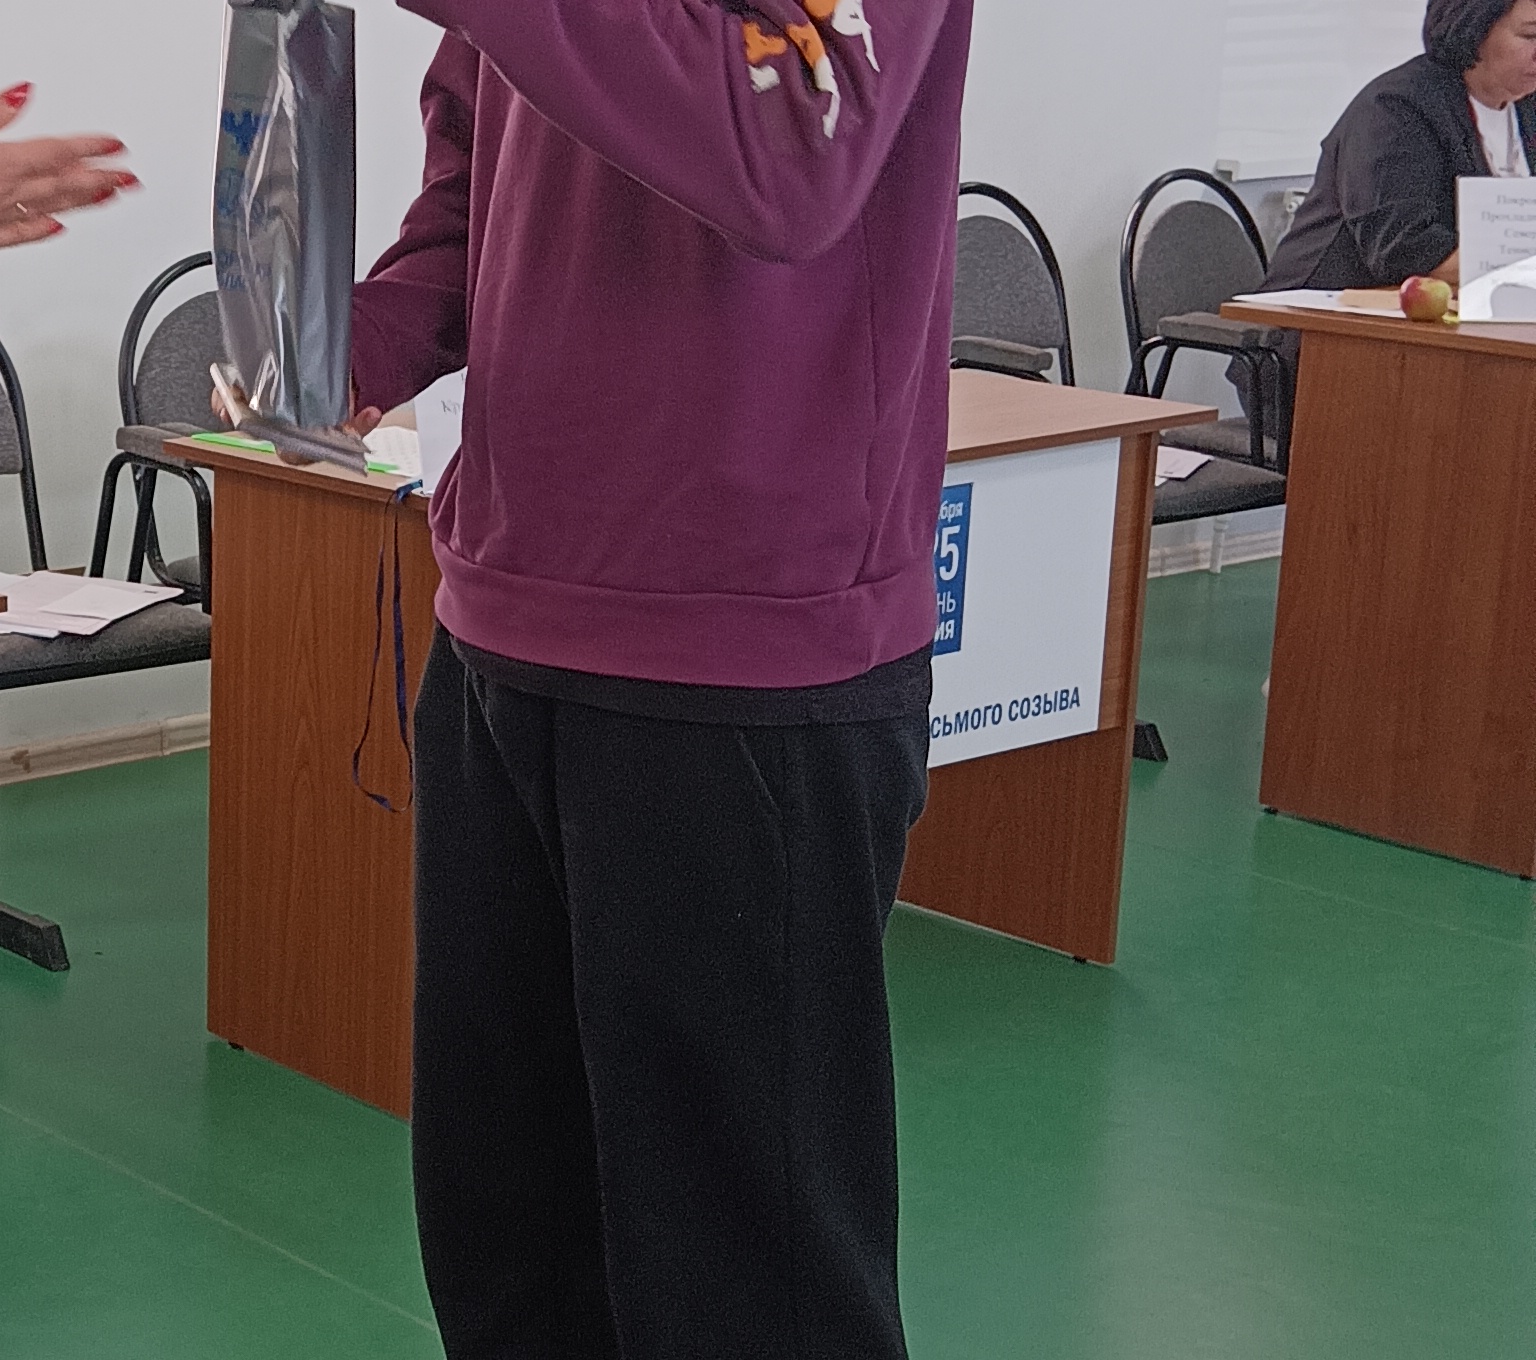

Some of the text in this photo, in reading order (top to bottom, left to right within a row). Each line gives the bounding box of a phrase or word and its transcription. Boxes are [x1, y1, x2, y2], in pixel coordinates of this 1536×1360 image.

[938, 501, 963, 522] бря
[933, 525, 961, 581] 5
[1008, 687, 1080, 722] СОЗЫВА
